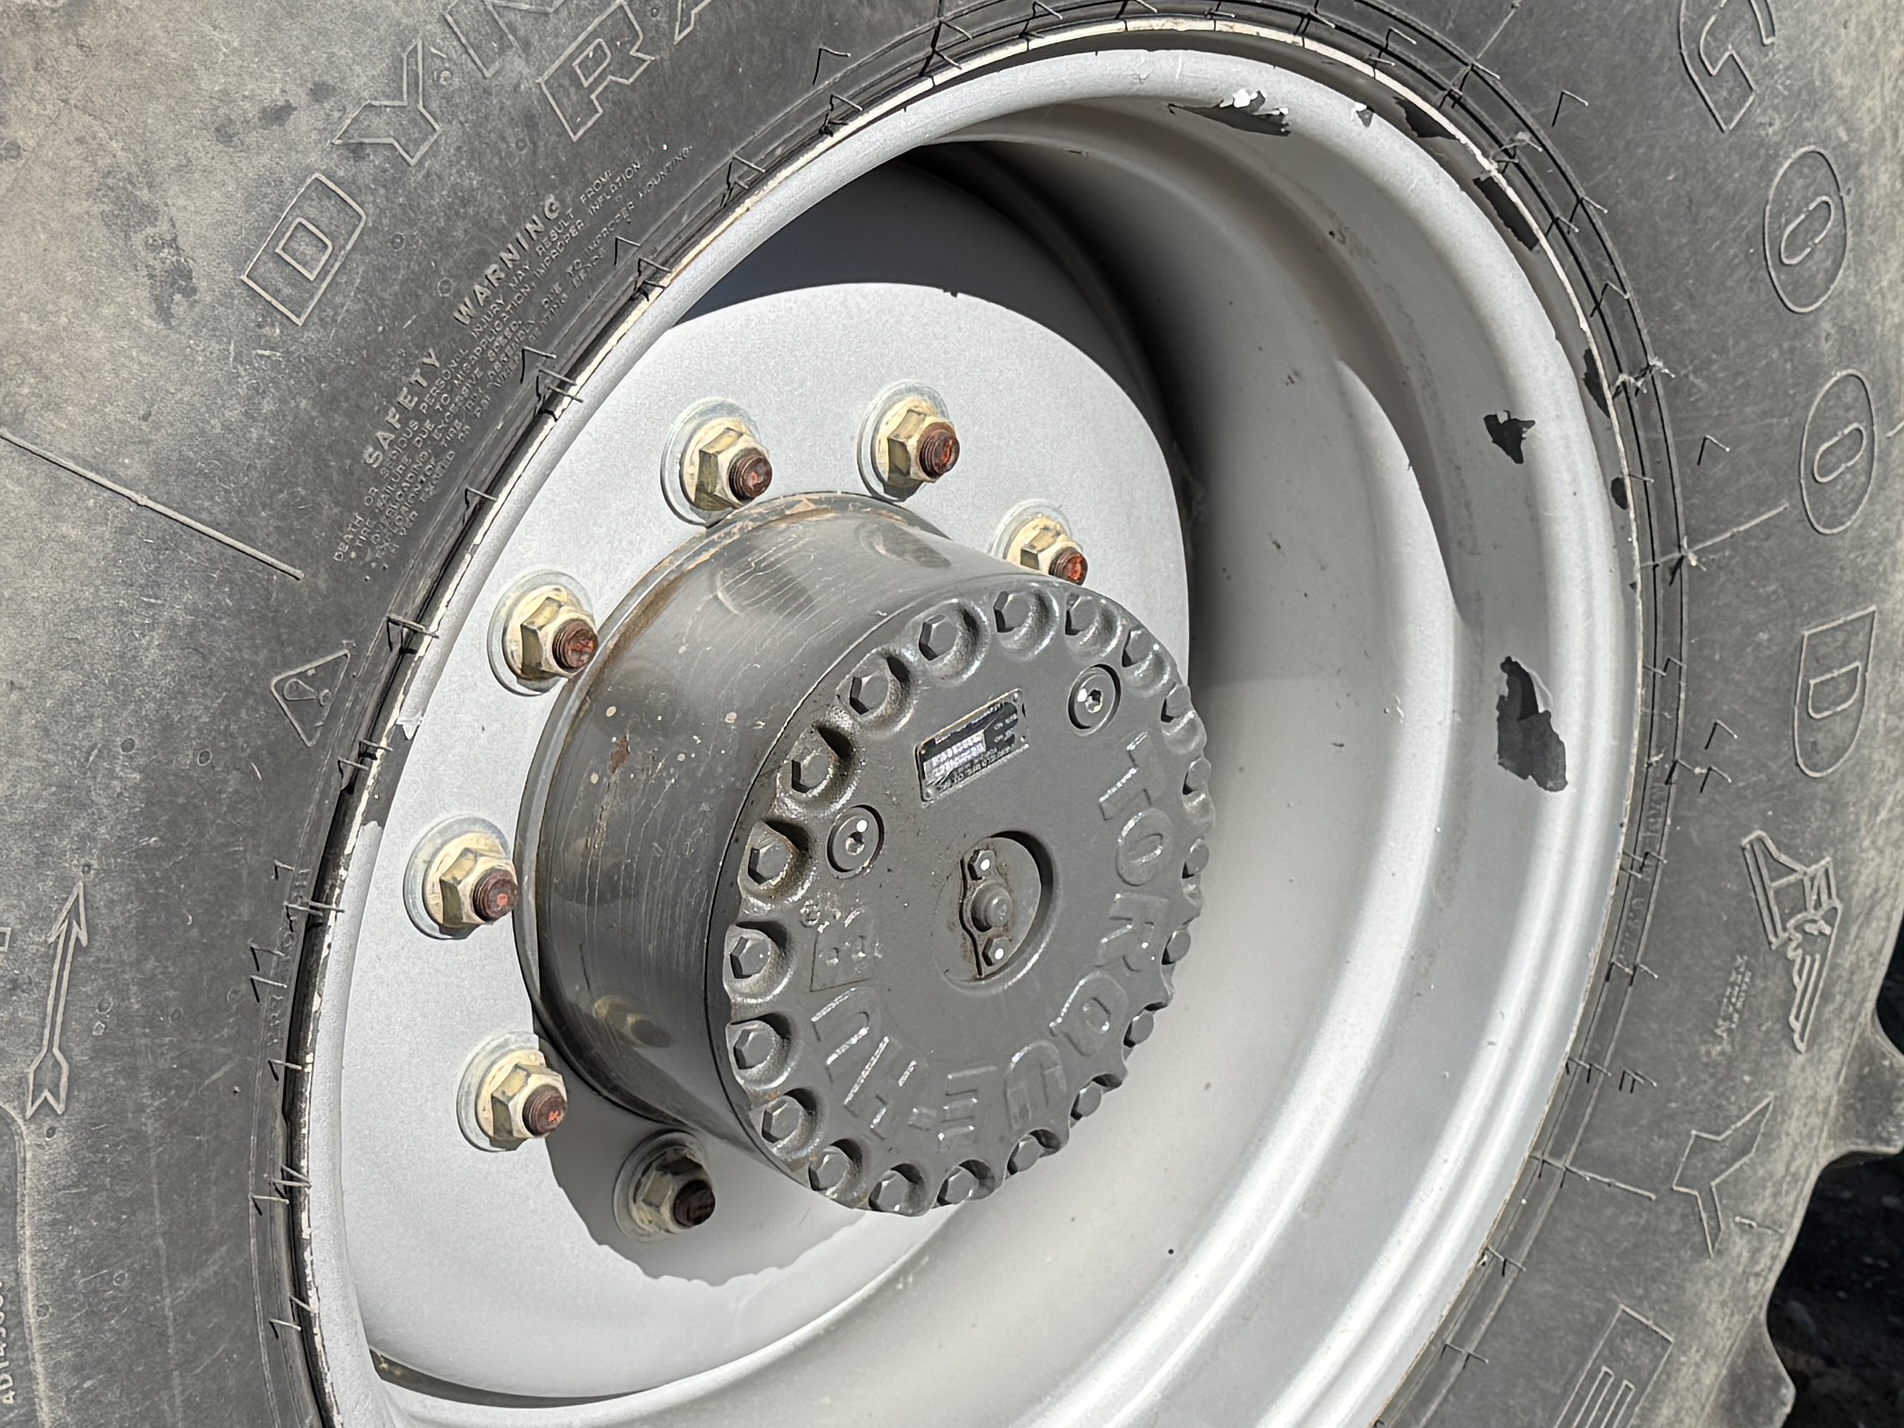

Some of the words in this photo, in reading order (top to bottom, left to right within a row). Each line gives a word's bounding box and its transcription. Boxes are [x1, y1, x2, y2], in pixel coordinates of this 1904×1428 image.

[330, 511, 365, 563] DEATH
[362, 484, 380, 508] OR
[378, 417, 420, 479] SERIOUS
[418, 344, 468, 414] PERSONAL
[468, 292, 508, 339] INJURY
[507, 260, 533, 290] MAY
[533, 207, 577, 256] RESULT
[355, 517, 375, 548] TIRE
[412, 418, 435, 448] DUE
[434, 392, 452, 413] TO
[533, 218, 586, 279] IMPROPER
[362, 346, 442, 470] SAFETY
[453, 193, 562, 326] WARNING
[432, 367, 483, 441] EXCESSIVE
[565, 257, 584, 277] TO
